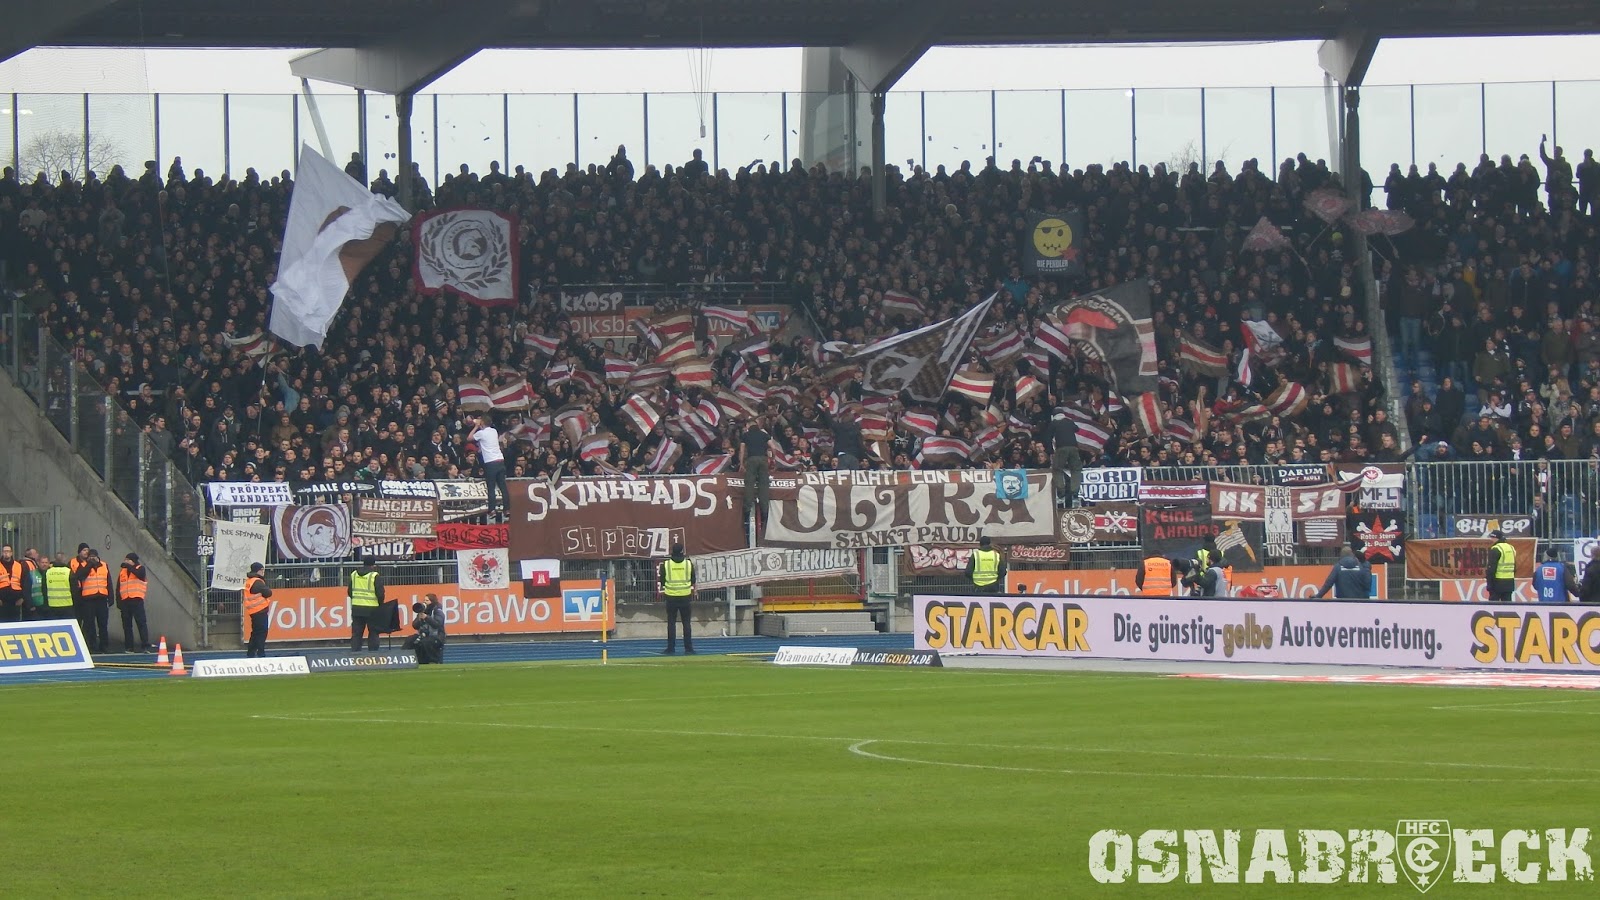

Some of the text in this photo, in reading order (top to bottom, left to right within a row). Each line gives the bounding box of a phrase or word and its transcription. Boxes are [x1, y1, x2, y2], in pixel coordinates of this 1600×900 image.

[910, 470, 950, 484] CON
[961, 470, 992, 483] NOI
[1080, 470, 1138, 483] ORD
[1278, 468, 1323, 477] DARUM
[312, 483, 339, 493] AALE
[1078, 483, 1138, 499] UPPORT
[1360, 487, 1398, 500] MFL
[231, 494, 291, 503] VENDETTA
[527, 478, 718, 521] SKINHEADS
[1265, 496, 1292, 508] EUCH
[361, 500, 434, 512] HINCHAS
[779, 480, 1037, 533] ULTRA
[352, 521, 432, 535] SZENARIO KAOS
[835, 526, 984, 548] SANKT PAULI
[1268, 544, 1293, 557] UNS
[695, 547, 855, 583] ENFANTS TERRIBLES
[442, 594, 551, 625] BraWo
[925, 600, 1091, 652] STARCAR
[1113, 612, 1142, 643] Die
[1279, 616, 1443, 660] Autovermietung.
[0, 632, 77, 661] ETRO
[776, 651, 933, 665] Diamonds24.de ANLAGEGOLD24.DE
[202, 655, 417, 676] Diamonds24.de ANLAGEGOLD24.DE
